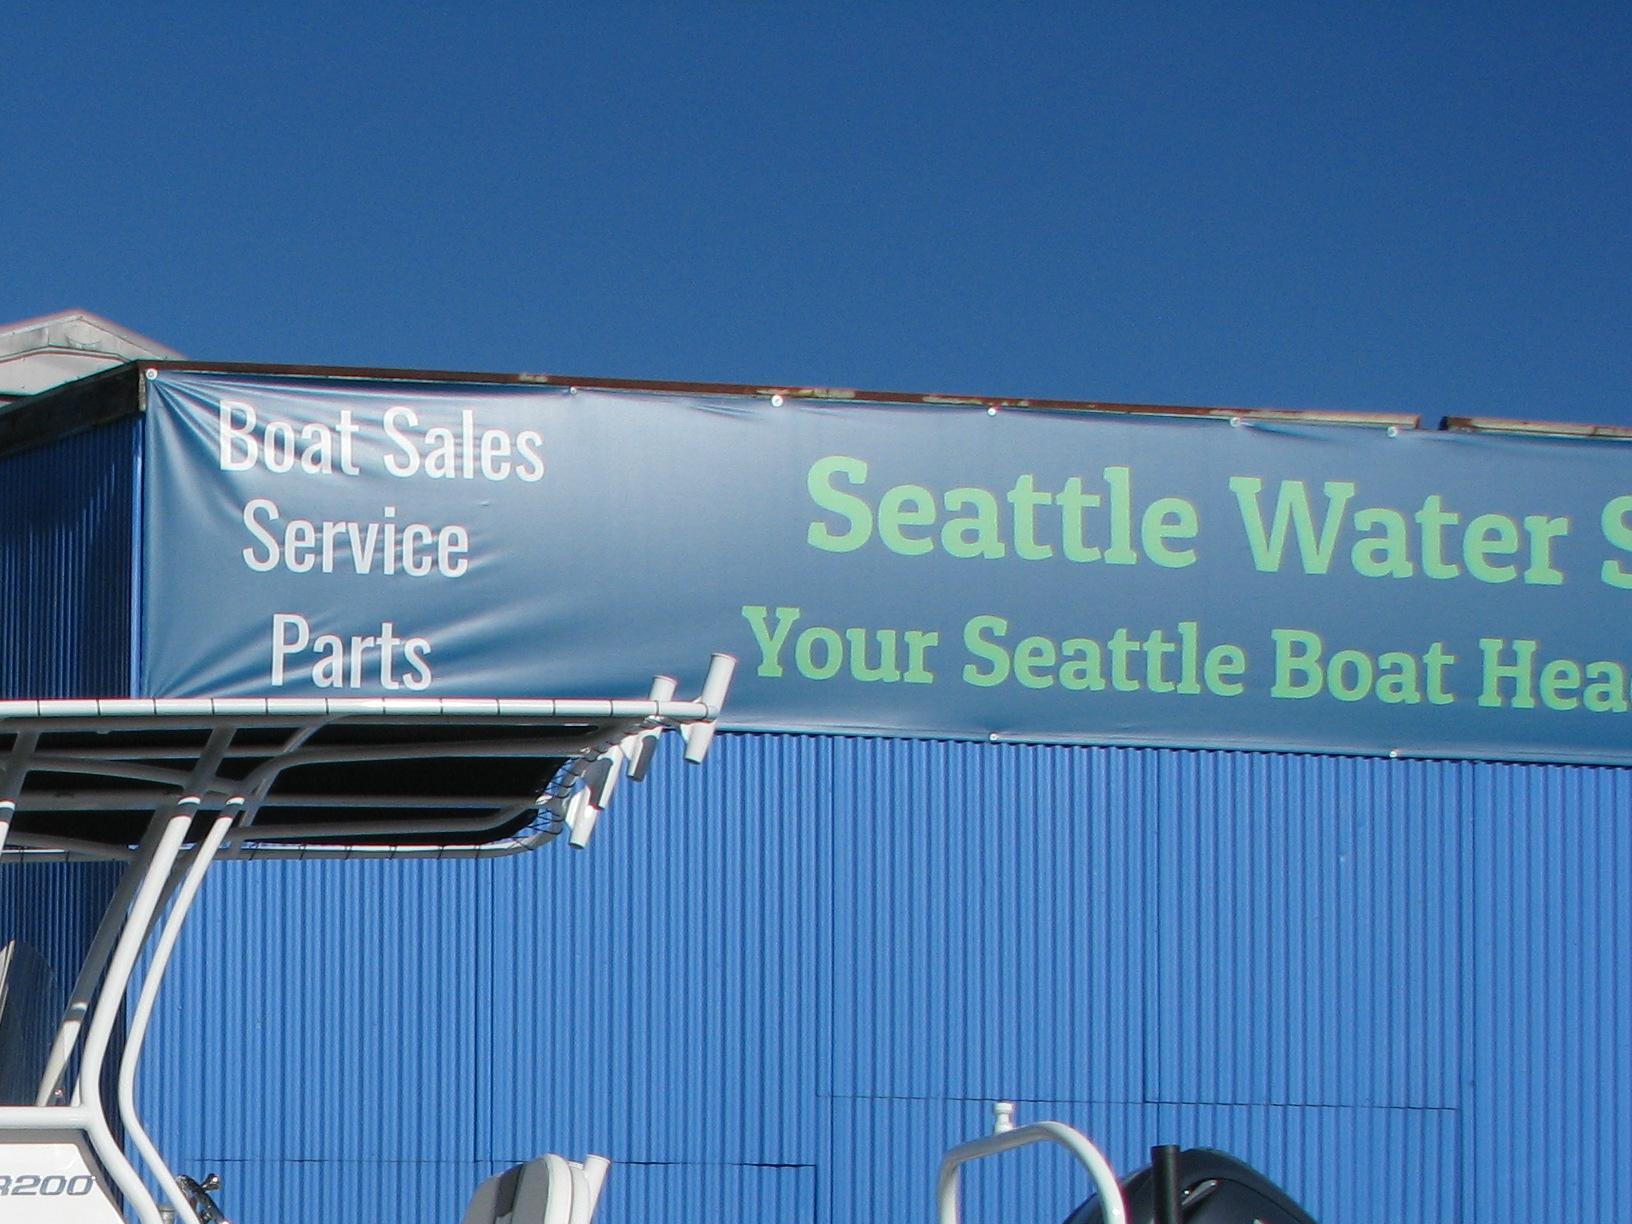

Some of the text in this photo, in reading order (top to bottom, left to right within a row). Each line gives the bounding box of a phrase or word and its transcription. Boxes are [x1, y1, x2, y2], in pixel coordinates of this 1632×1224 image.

[219, 399, 546, 482] Boat Sales
[241, 498, 470, 578] Service
[805, 454, 1200, 569] Seattle
[1228, 474, 1571, 586] Water
[270, 613, 433, 691] Parts
[740, 603, 1632, 713] Your Seattle Boat Hea
